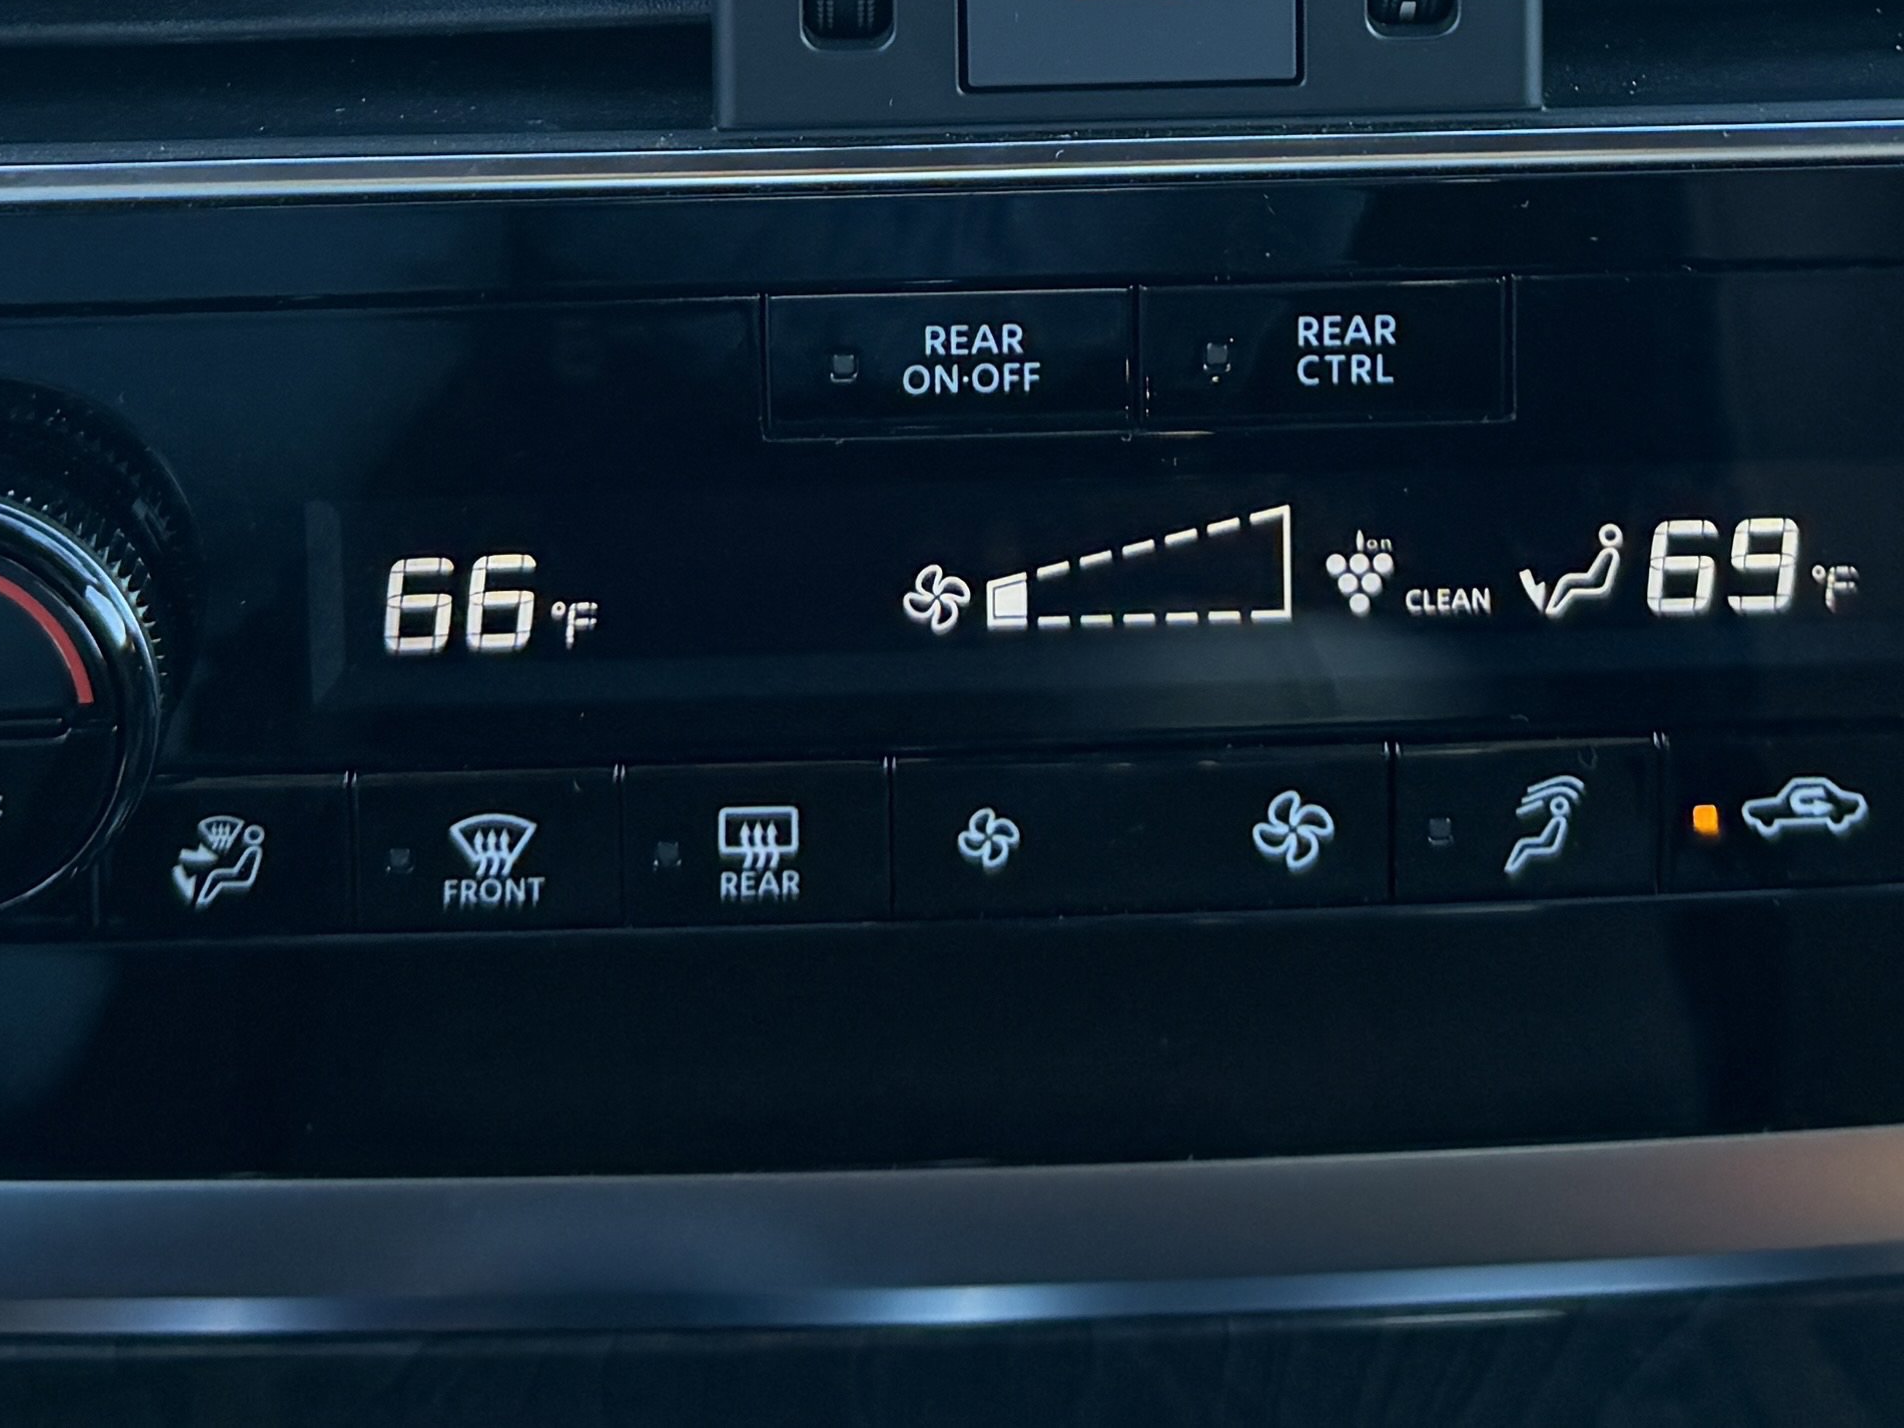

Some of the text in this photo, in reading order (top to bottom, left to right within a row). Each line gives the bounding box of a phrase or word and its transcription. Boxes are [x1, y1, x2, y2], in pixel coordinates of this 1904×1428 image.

[923, 322, 1024, 357] REAR
[1297, 313, 1399, 348] REAR
[1296, 353, 1395, 387] CTRL
[1646, 516, 1801, 617] 69
[382, 552, 538, 657] 66
[1404, 587, 1493, 616] CLEAN
[442, 875, 546, 912] FRONT
[719, 870, 801, 904] REAR
